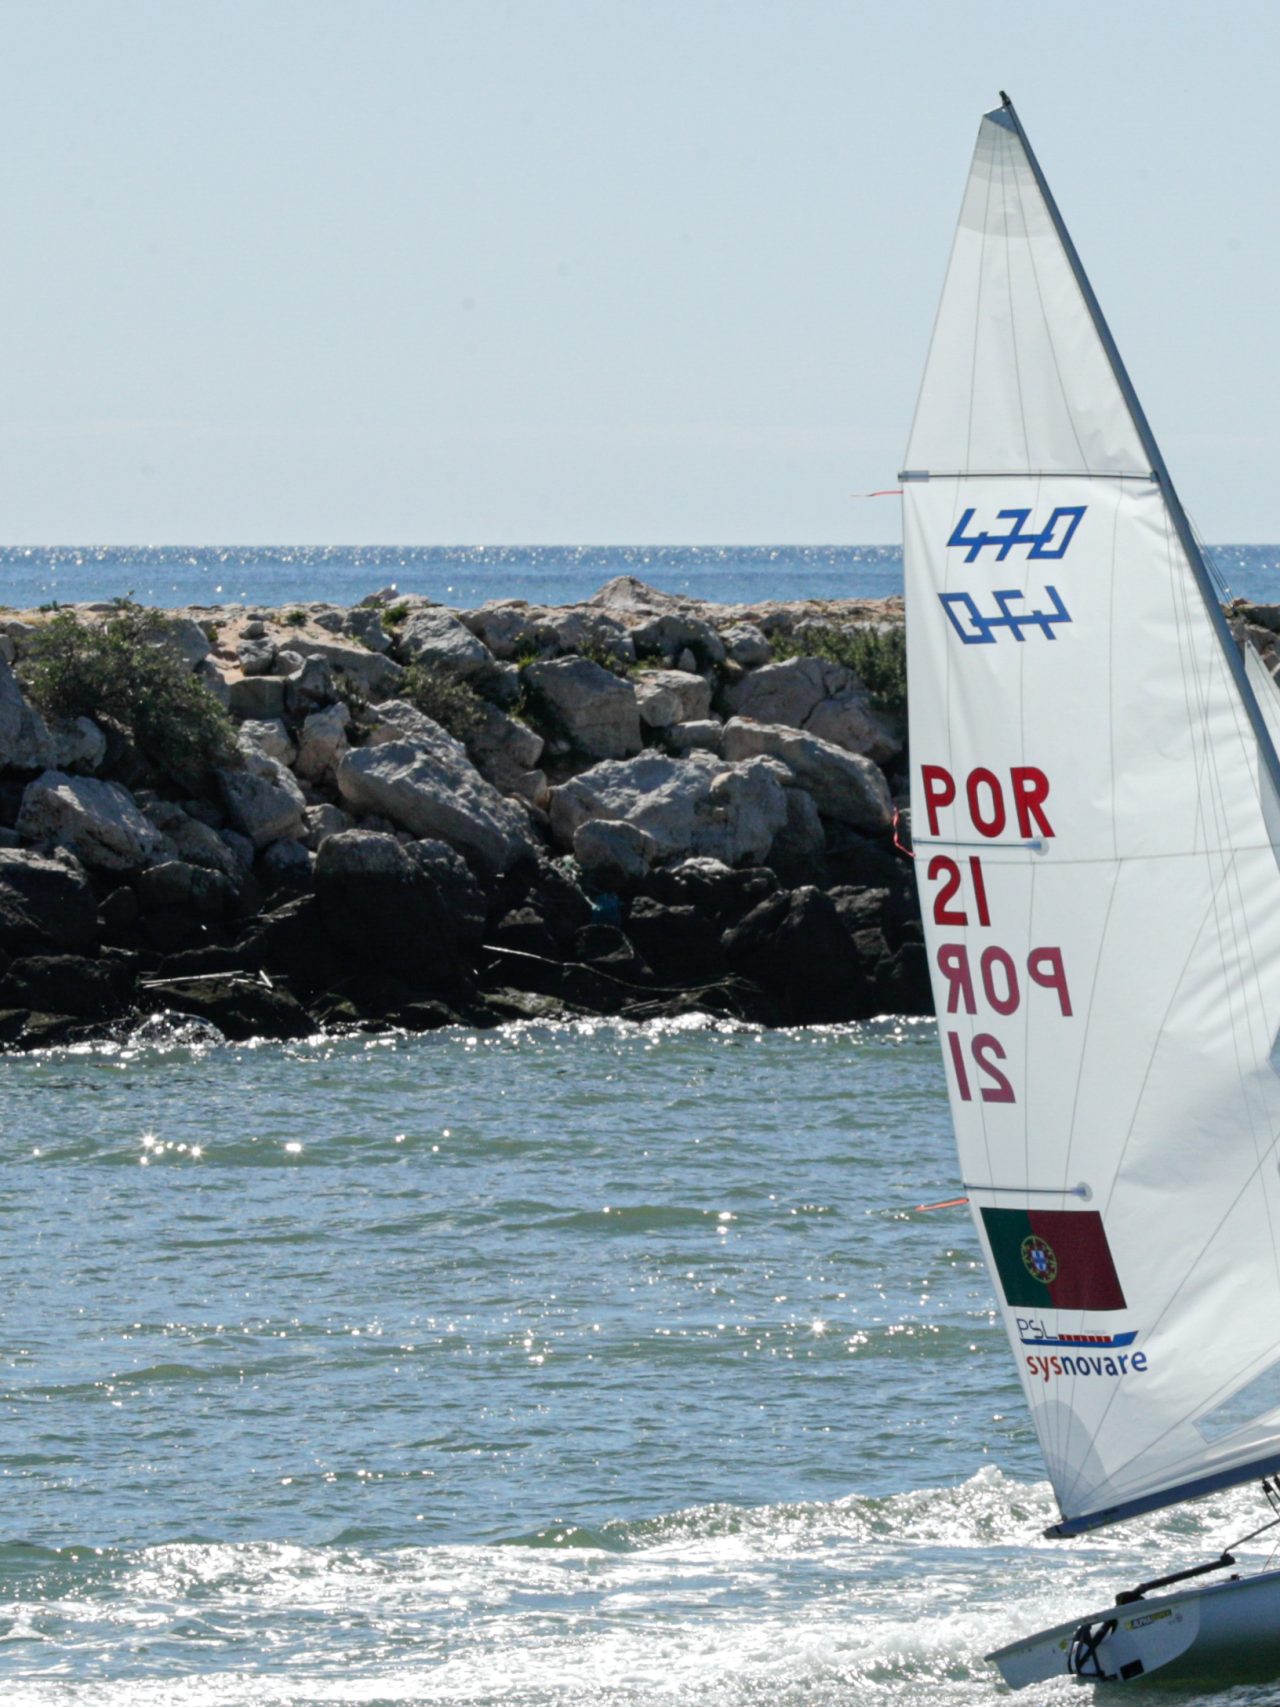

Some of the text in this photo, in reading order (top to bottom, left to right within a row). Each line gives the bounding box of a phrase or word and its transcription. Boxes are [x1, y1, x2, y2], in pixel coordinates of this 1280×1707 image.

[946, 505, 1088, 563] 470
[921, 764, 1056, 838] POR
[927, 855, 991, 927] 21
[1016, 1318, 1058, 1340] PSL
[1026, 1350, 1148, 1383] sysnovare
